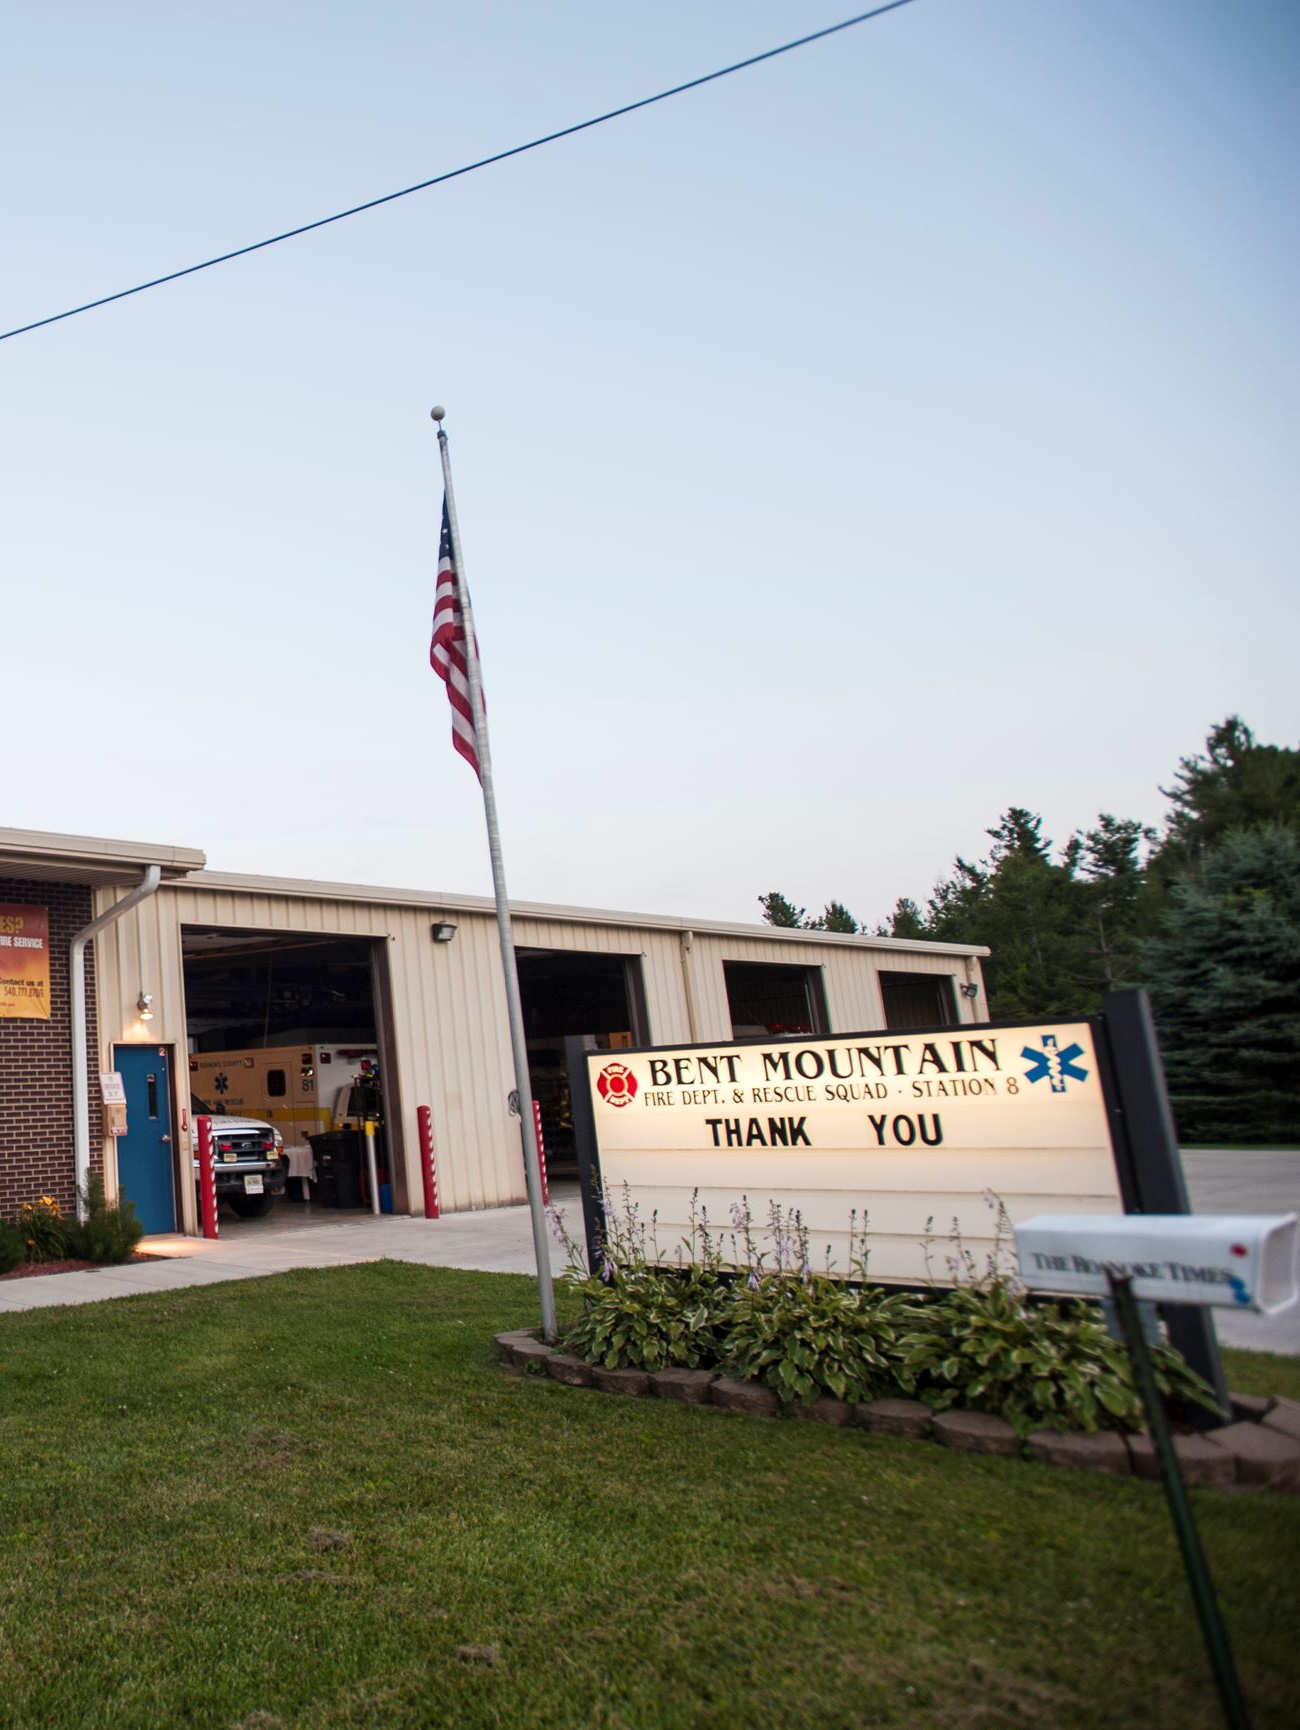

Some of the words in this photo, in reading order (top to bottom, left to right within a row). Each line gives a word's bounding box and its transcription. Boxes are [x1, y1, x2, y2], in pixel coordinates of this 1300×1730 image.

[13, 936, 45, 949] SERVICE
[36, 979, 44, 987] at
[648, 1054, 744, 1087] BENT
[761, 1037, 1003, 1082] MOUNTAIN
[301, 1079, 314, 1092] 81
[644, 1091, 676, 1107] FIRE
[682, 1089, 725, 1105] DEPT.
[732, 1088, 744, 1104] &
[751, 1085, 817, 1103] RESCUE
[824, 1082, 888, 1103] SQUAD
[912, 1078, 999, 1098] STATION
[1006, 1076, 1020, 1096] 8
[705, 1116, 812, 1148] THANK
[868, 1112, 944, 1147] YOU
[1031, 1252, 1068, 1272] THE
[1164, 1261, 1233, 1284] TIMES
